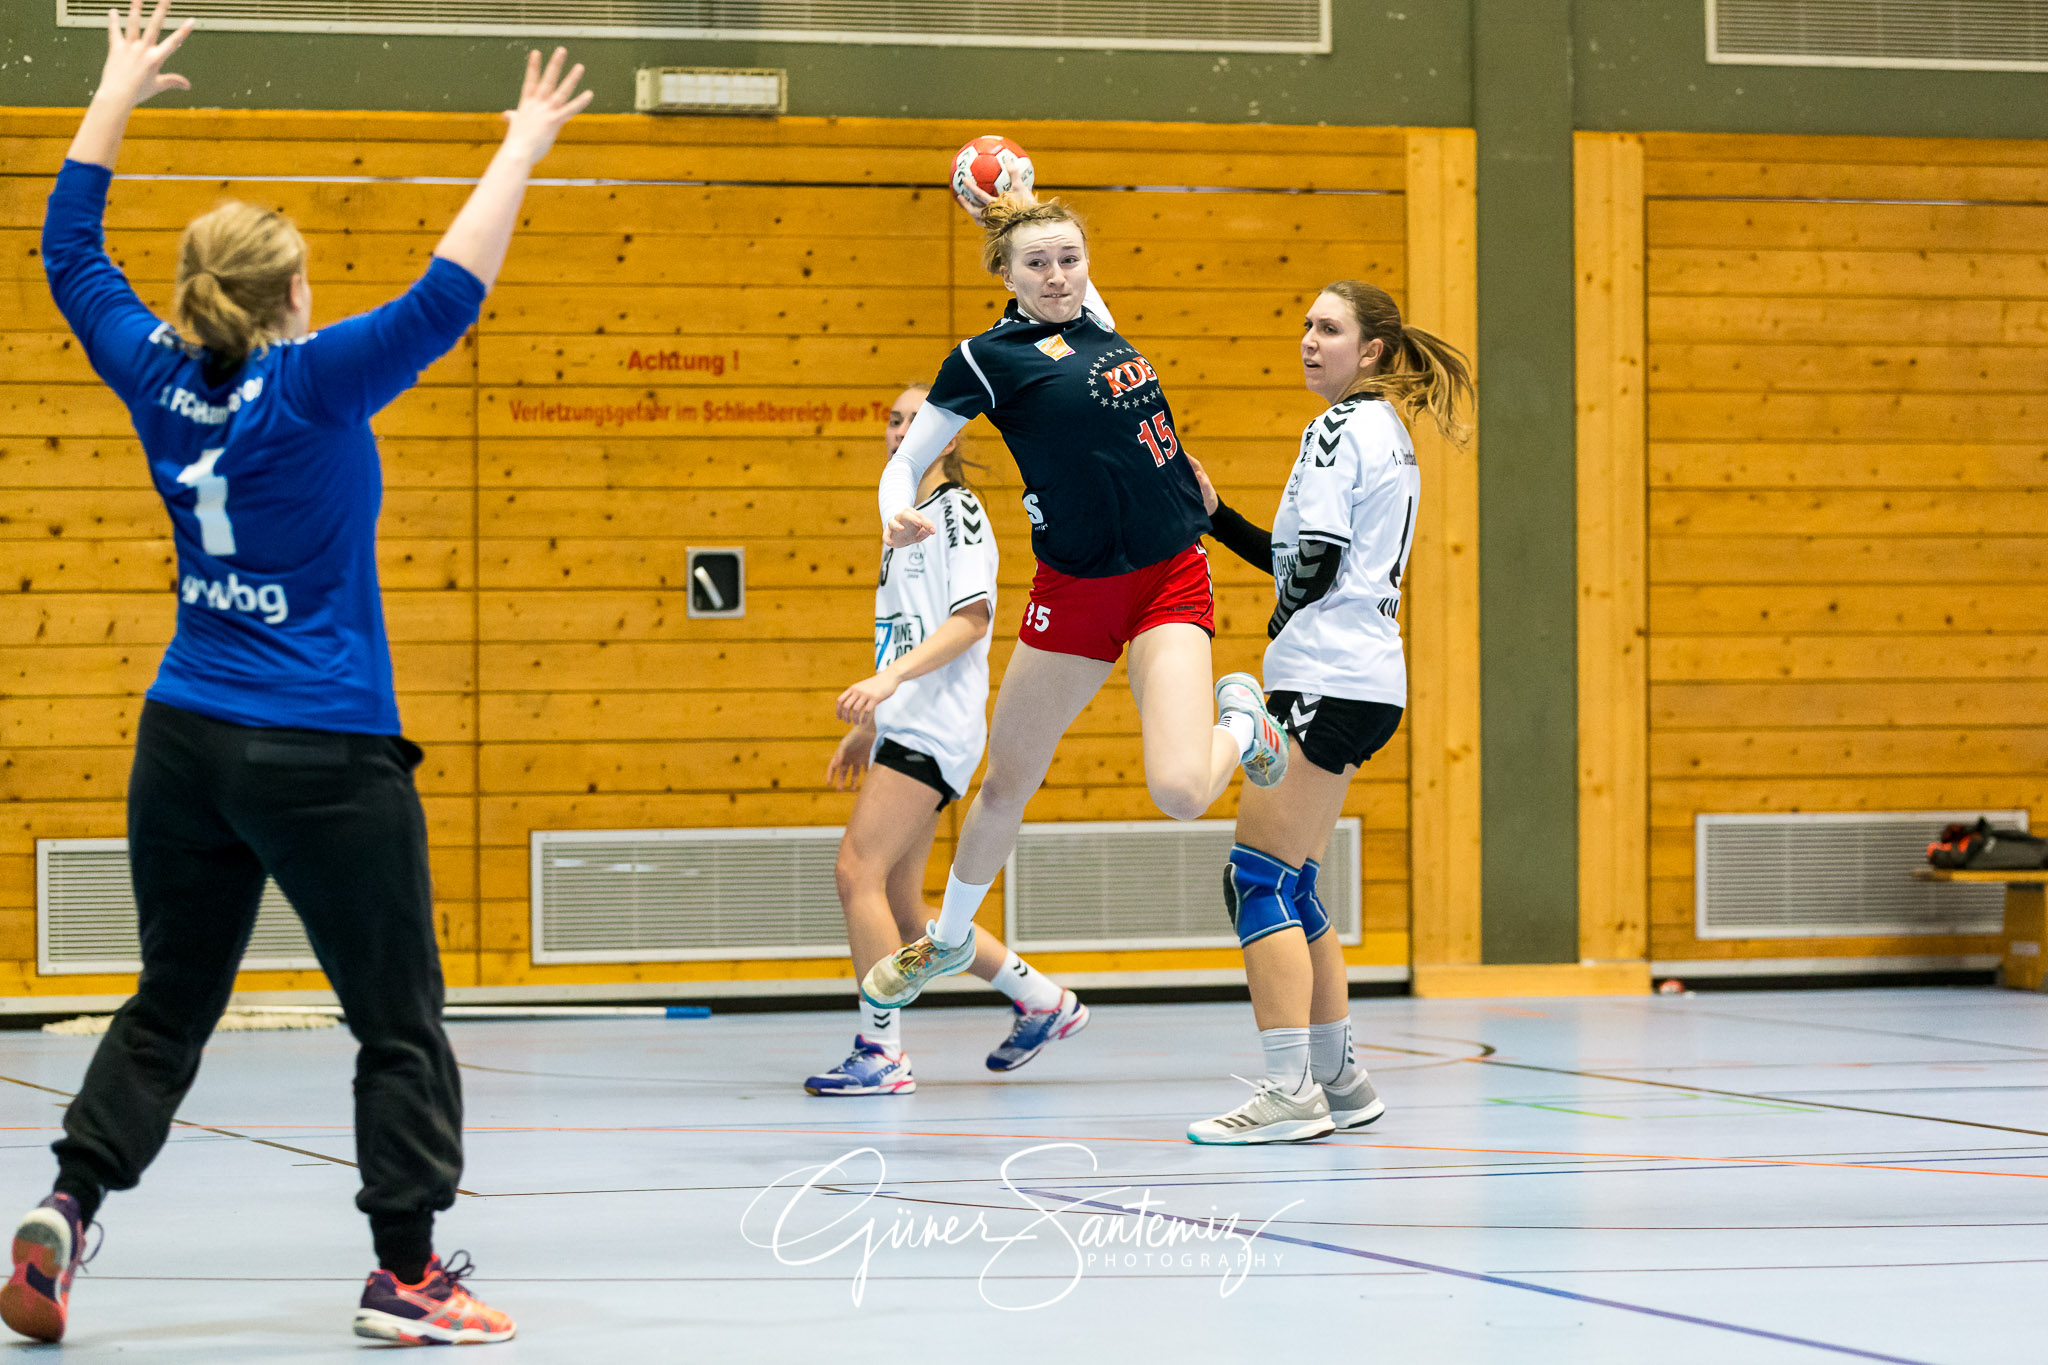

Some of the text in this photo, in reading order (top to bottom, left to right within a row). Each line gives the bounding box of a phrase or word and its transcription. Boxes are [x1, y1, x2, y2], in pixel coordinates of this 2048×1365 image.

[627, 350, 725, 377] Achtung
[509, 400, 670, 427] Verletzungsgefahr
[676, 402, 698, 421] im
[838, 402, 867, 421] der
[872, 401, 893, 421] To
[1137, 410, 1178, 468] 15
[176, 447, 237, 556] 1
[1026, 601, 1052, 632] 15
